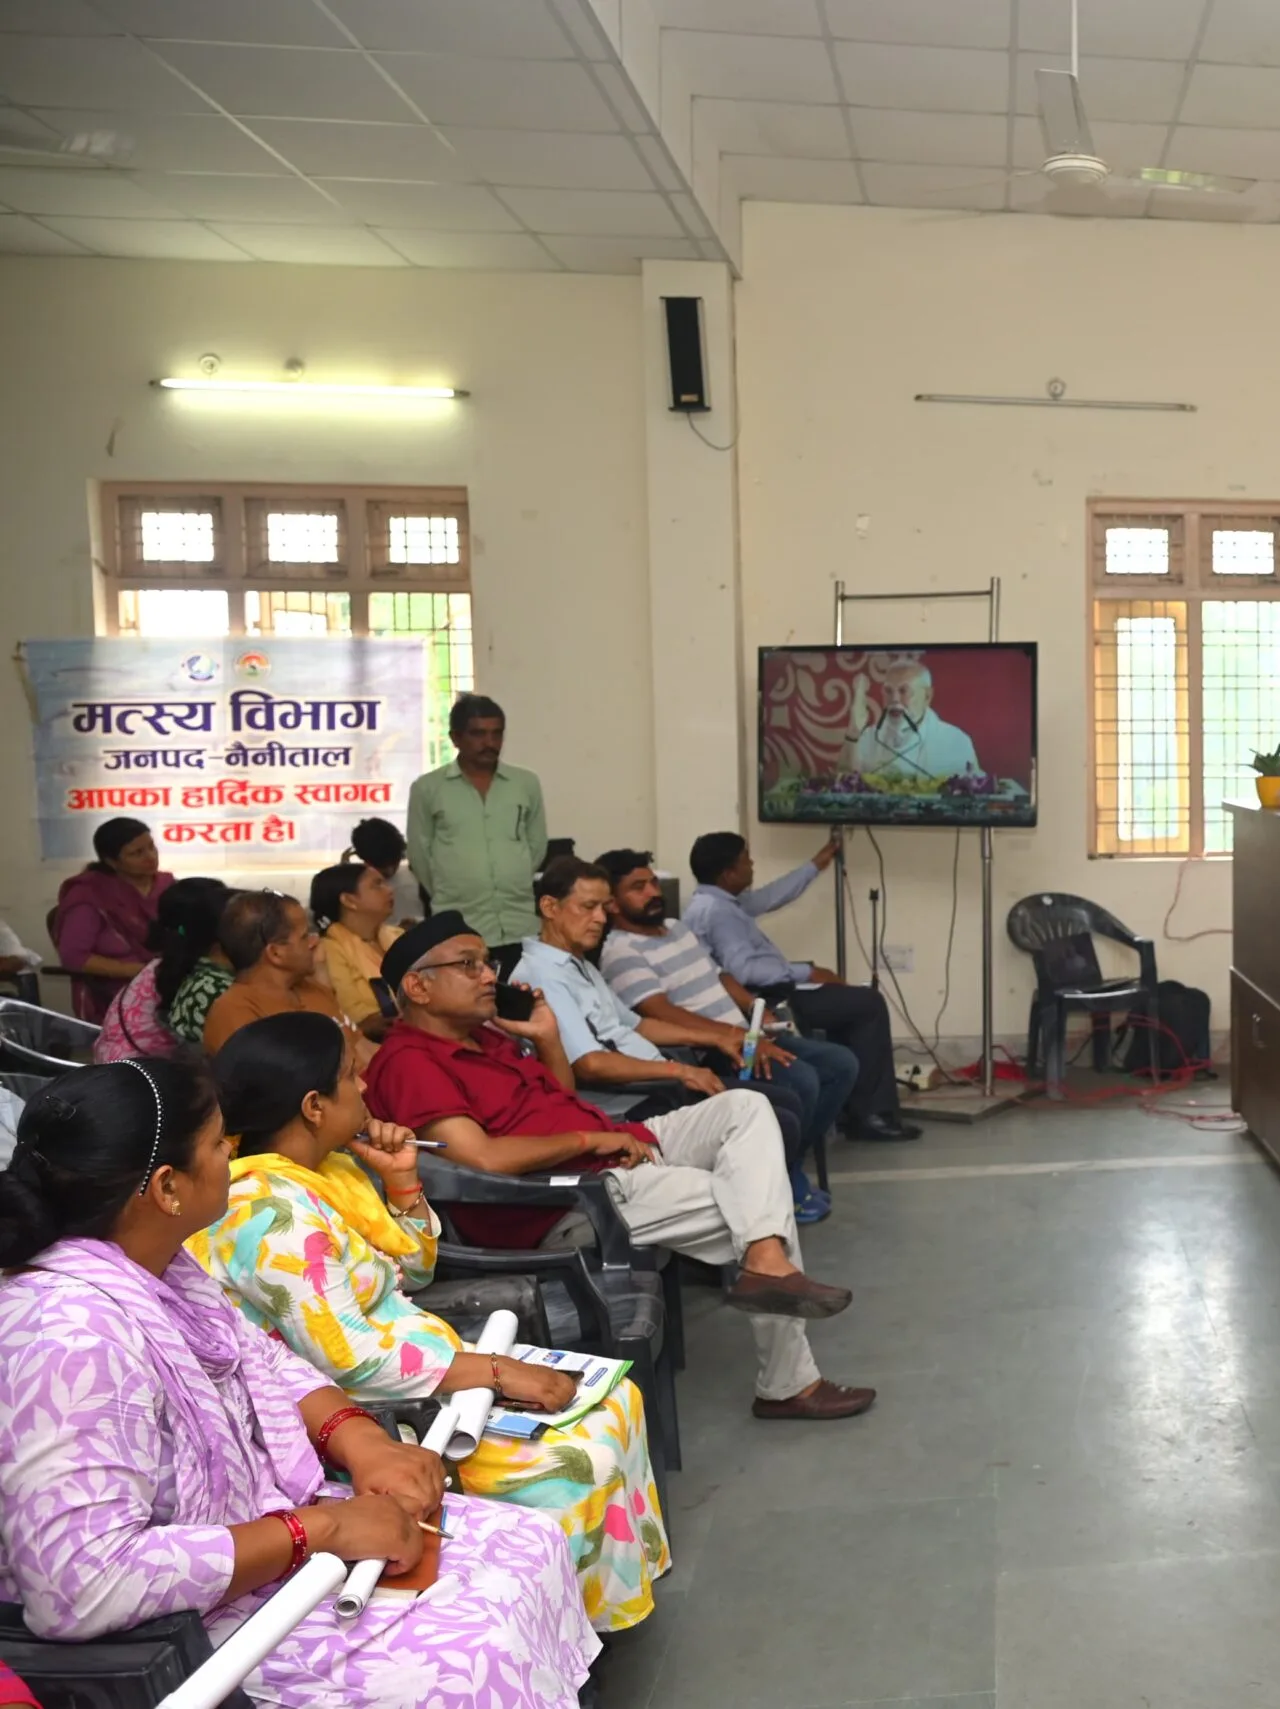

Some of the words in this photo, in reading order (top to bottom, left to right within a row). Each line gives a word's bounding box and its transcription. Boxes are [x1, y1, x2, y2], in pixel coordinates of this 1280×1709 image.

[73, 700, 215, 735] मत्स्य
[229, 690, 381, 732] विभाग
[104, 741, 352, 769] जनपद-नैनीताल
[67, 786, 172, 810] आपका
[181, 778, 284, 807] हार्दिक
[293, 782, 392, 805] स्वागत
[163, 821, 253, 844] करता
[262, 815, 294, 843] है।
